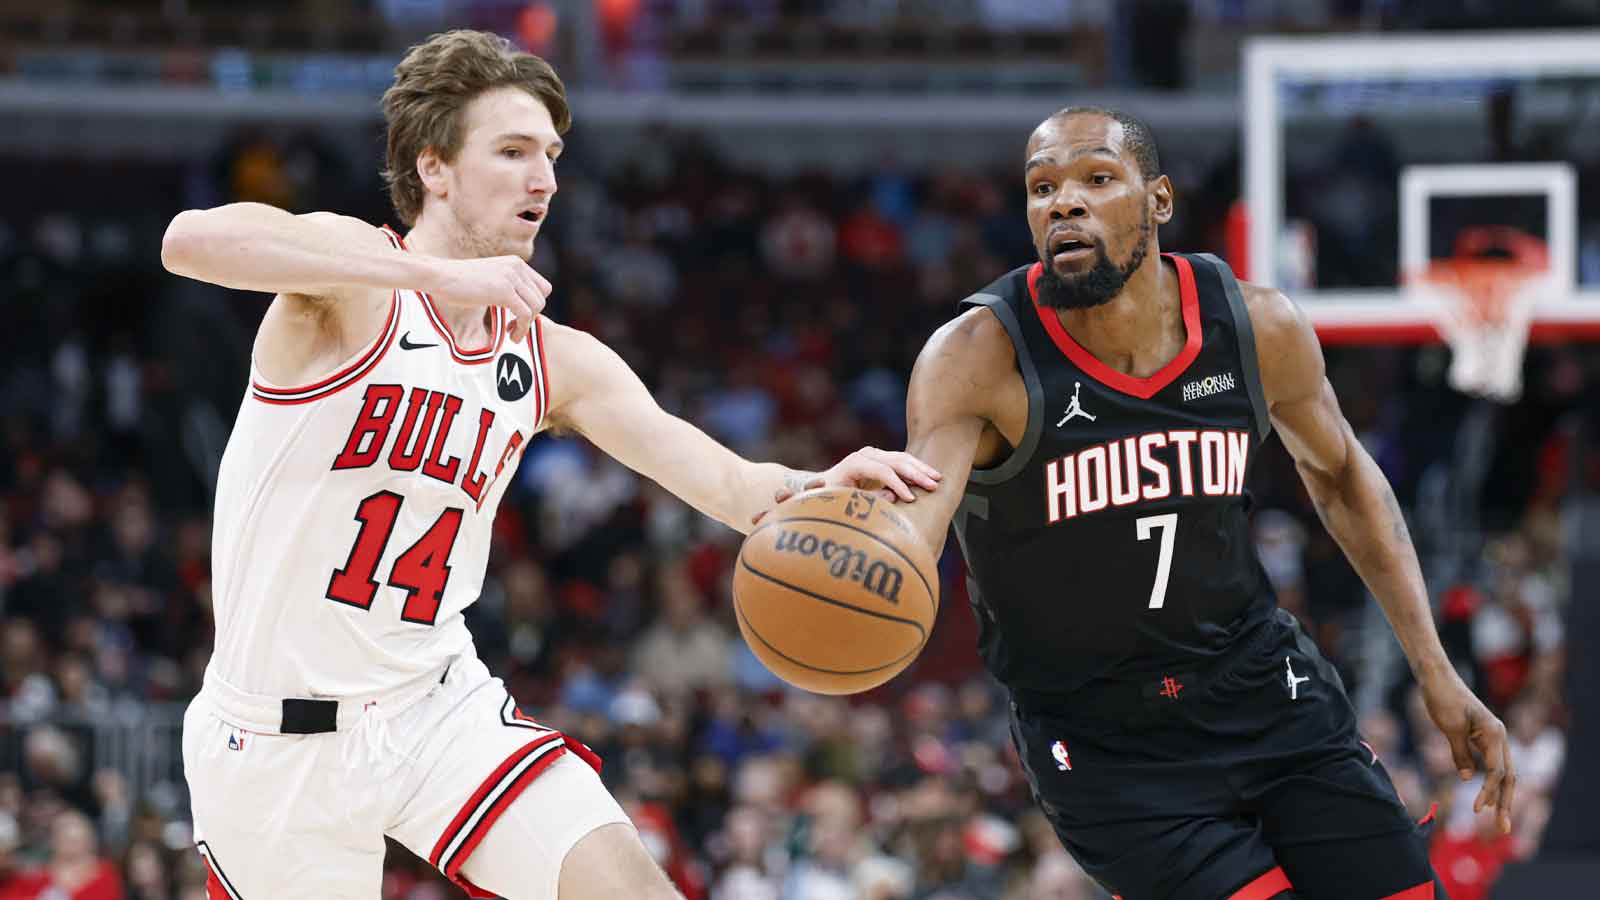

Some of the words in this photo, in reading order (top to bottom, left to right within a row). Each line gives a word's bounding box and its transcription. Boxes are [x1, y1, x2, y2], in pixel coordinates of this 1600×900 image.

[1183, 372, 1234, 392] MEMORIAL
[1183, 379, 1235, 401] HERMANN
[1046, 429, 1249, 525] HOUSTON
[325, 489, 464, 626] 14
[775, 529, 903, 605] Wilson
[1136, 513, 1178, 609] 7
